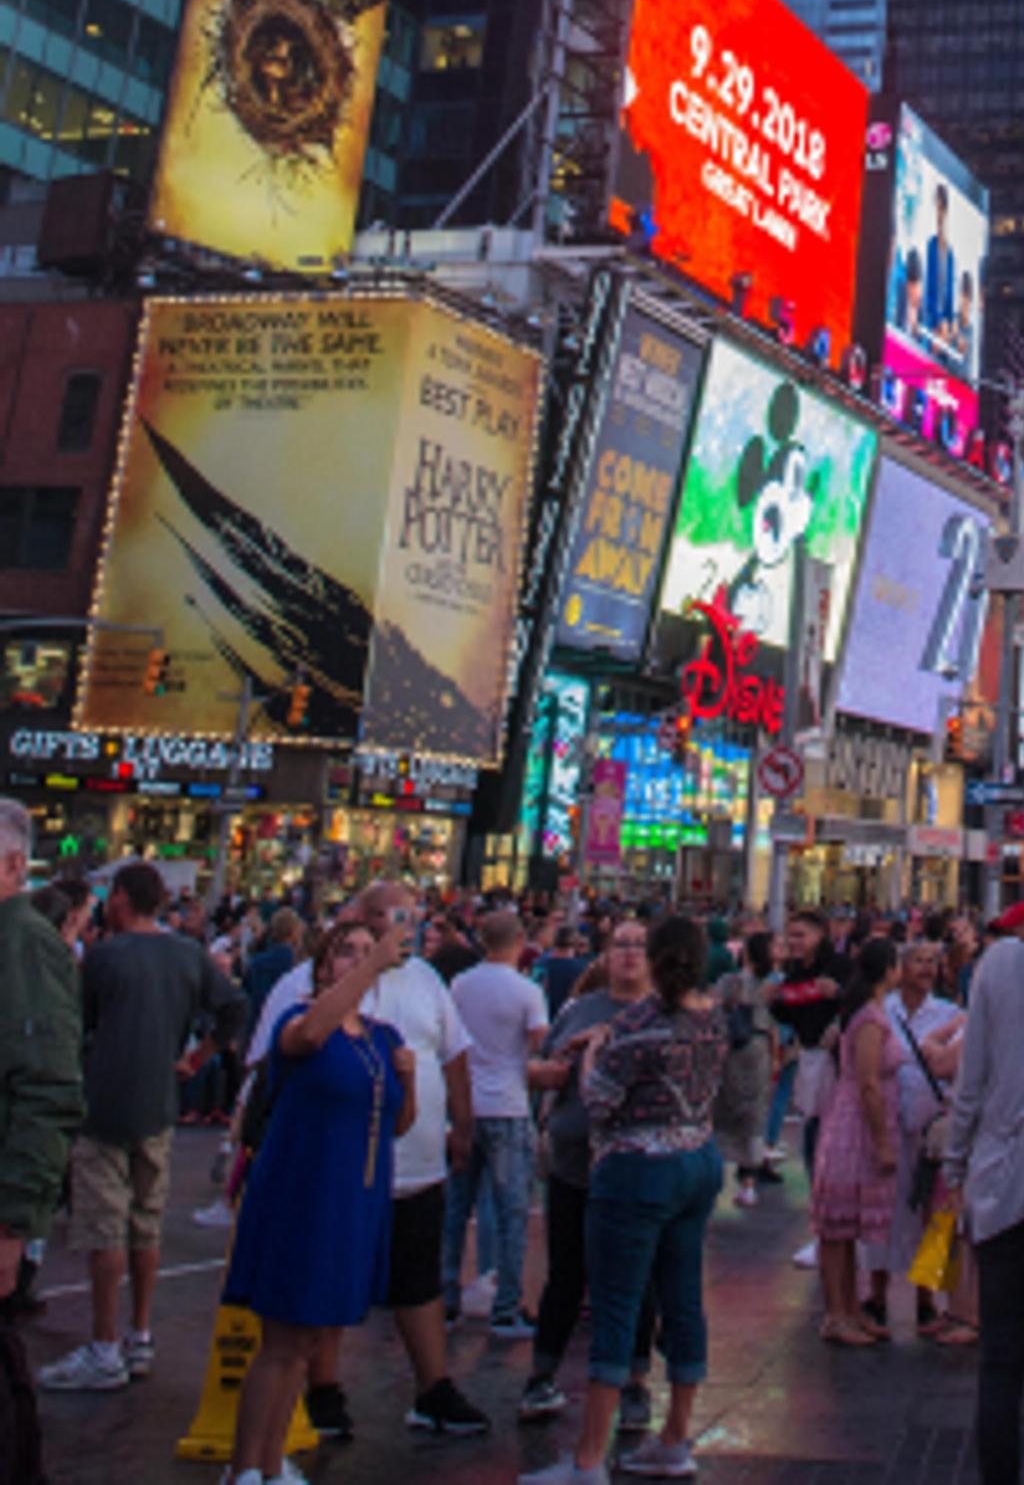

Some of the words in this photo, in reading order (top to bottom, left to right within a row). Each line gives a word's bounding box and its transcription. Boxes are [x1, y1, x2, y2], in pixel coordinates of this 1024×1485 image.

[690, 25, 826, 180] 9.29.2018
[669, 81, 774, 196] CENTRAL
[778, 167, 832, 242] PARK
[420, 373, 470, 420] BEST
[470, 398, 520, 441] PLAY
[414, 436, 512, 513] HARRY
[598, 449, 672, 513] COME
[399, 486, 507, 575] POTTER
[575, 537, 656, 596] AWAY
[10, 730, 99, 759] GIFTS
